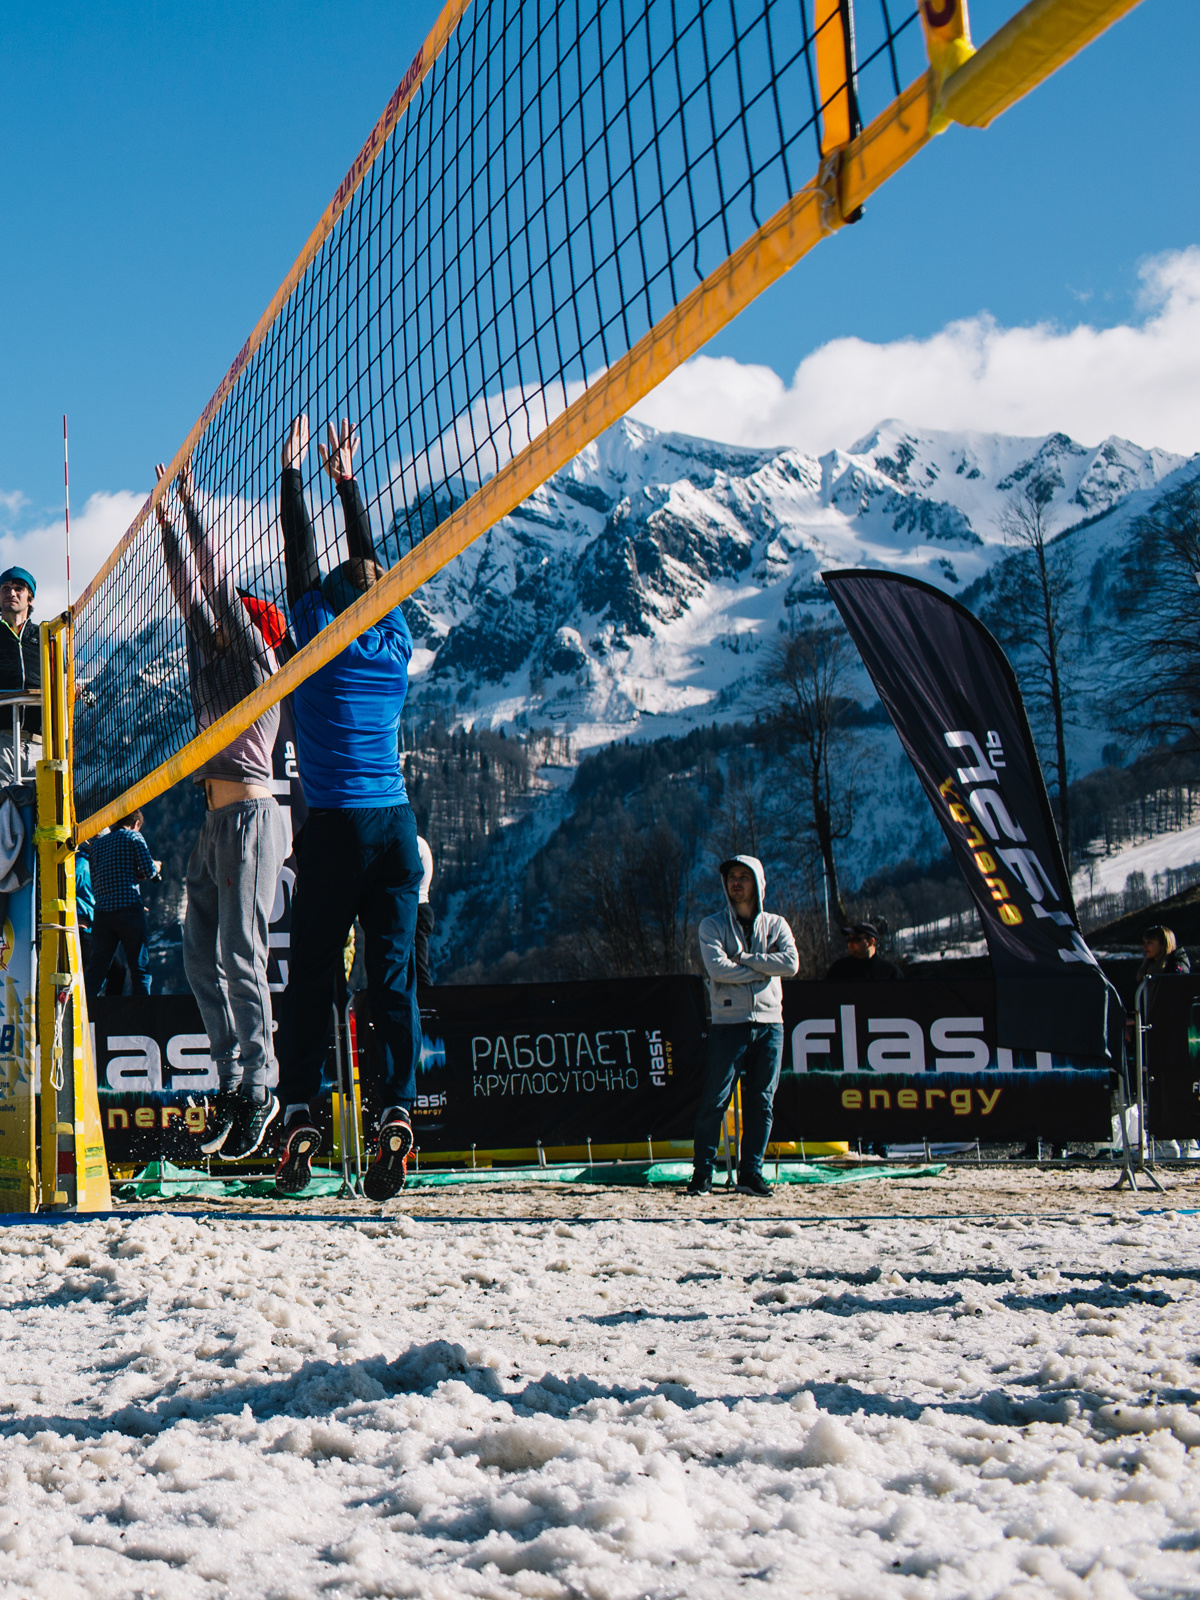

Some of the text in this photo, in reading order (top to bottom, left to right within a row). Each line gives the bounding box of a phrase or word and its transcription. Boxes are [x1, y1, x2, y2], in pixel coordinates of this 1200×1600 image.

[471, 1029, 636, 1071] РАБОТАЕТ
[649, 1030, 666, 1086] flash
[473, 1067, 639, 1097] КРУГЛОСУТОЧНО
[841, 1088, 1003, 1115] energy
[107, 1105, 216, 1133] nerg
